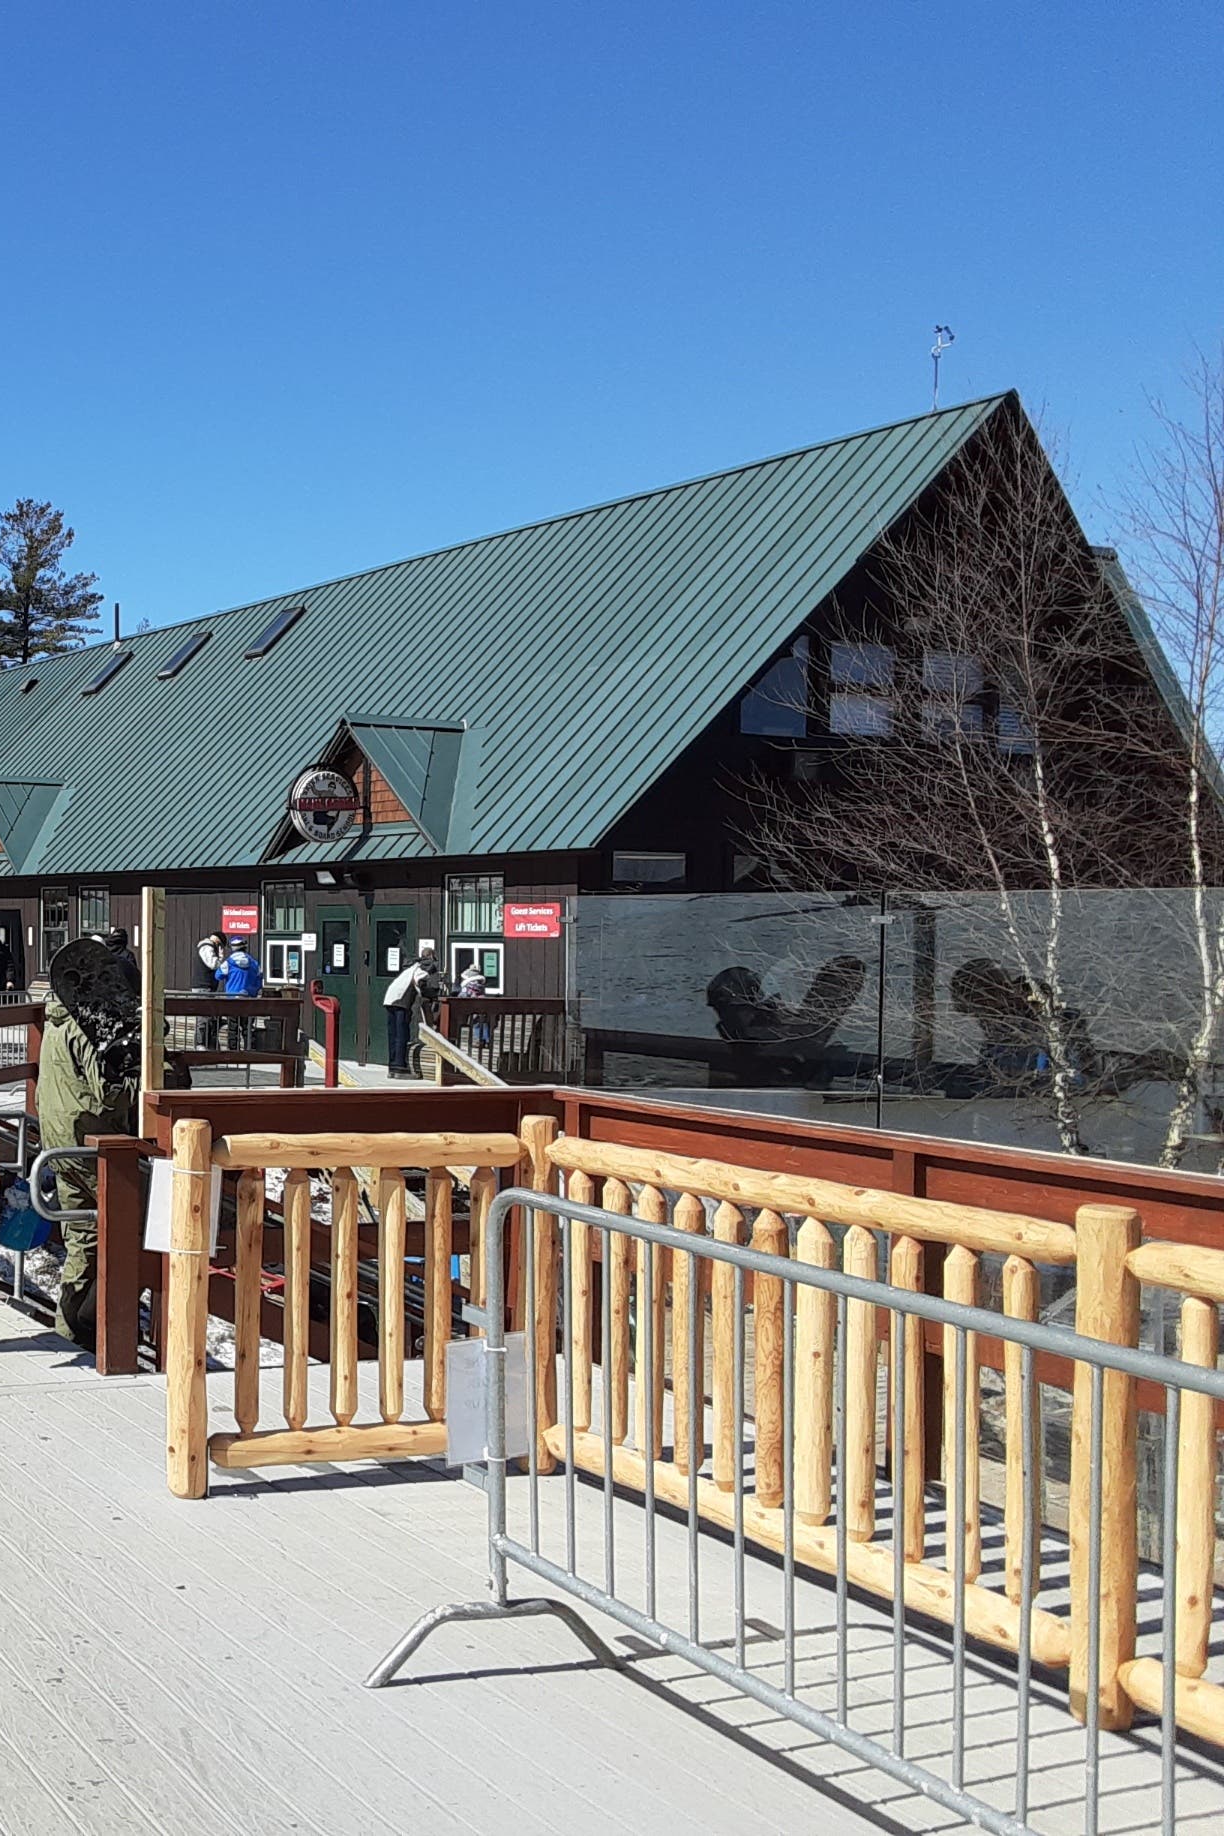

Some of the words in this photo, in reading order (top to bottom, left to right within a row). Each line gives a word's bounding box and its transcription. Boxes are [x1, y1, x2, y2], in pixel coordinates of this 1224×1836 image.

[511, 907, 528, 915] Guest
[528, 907, 553, 915] Services
[515, 923, 525, 931] Lift
[526, 923, 548, 932] Tickets
